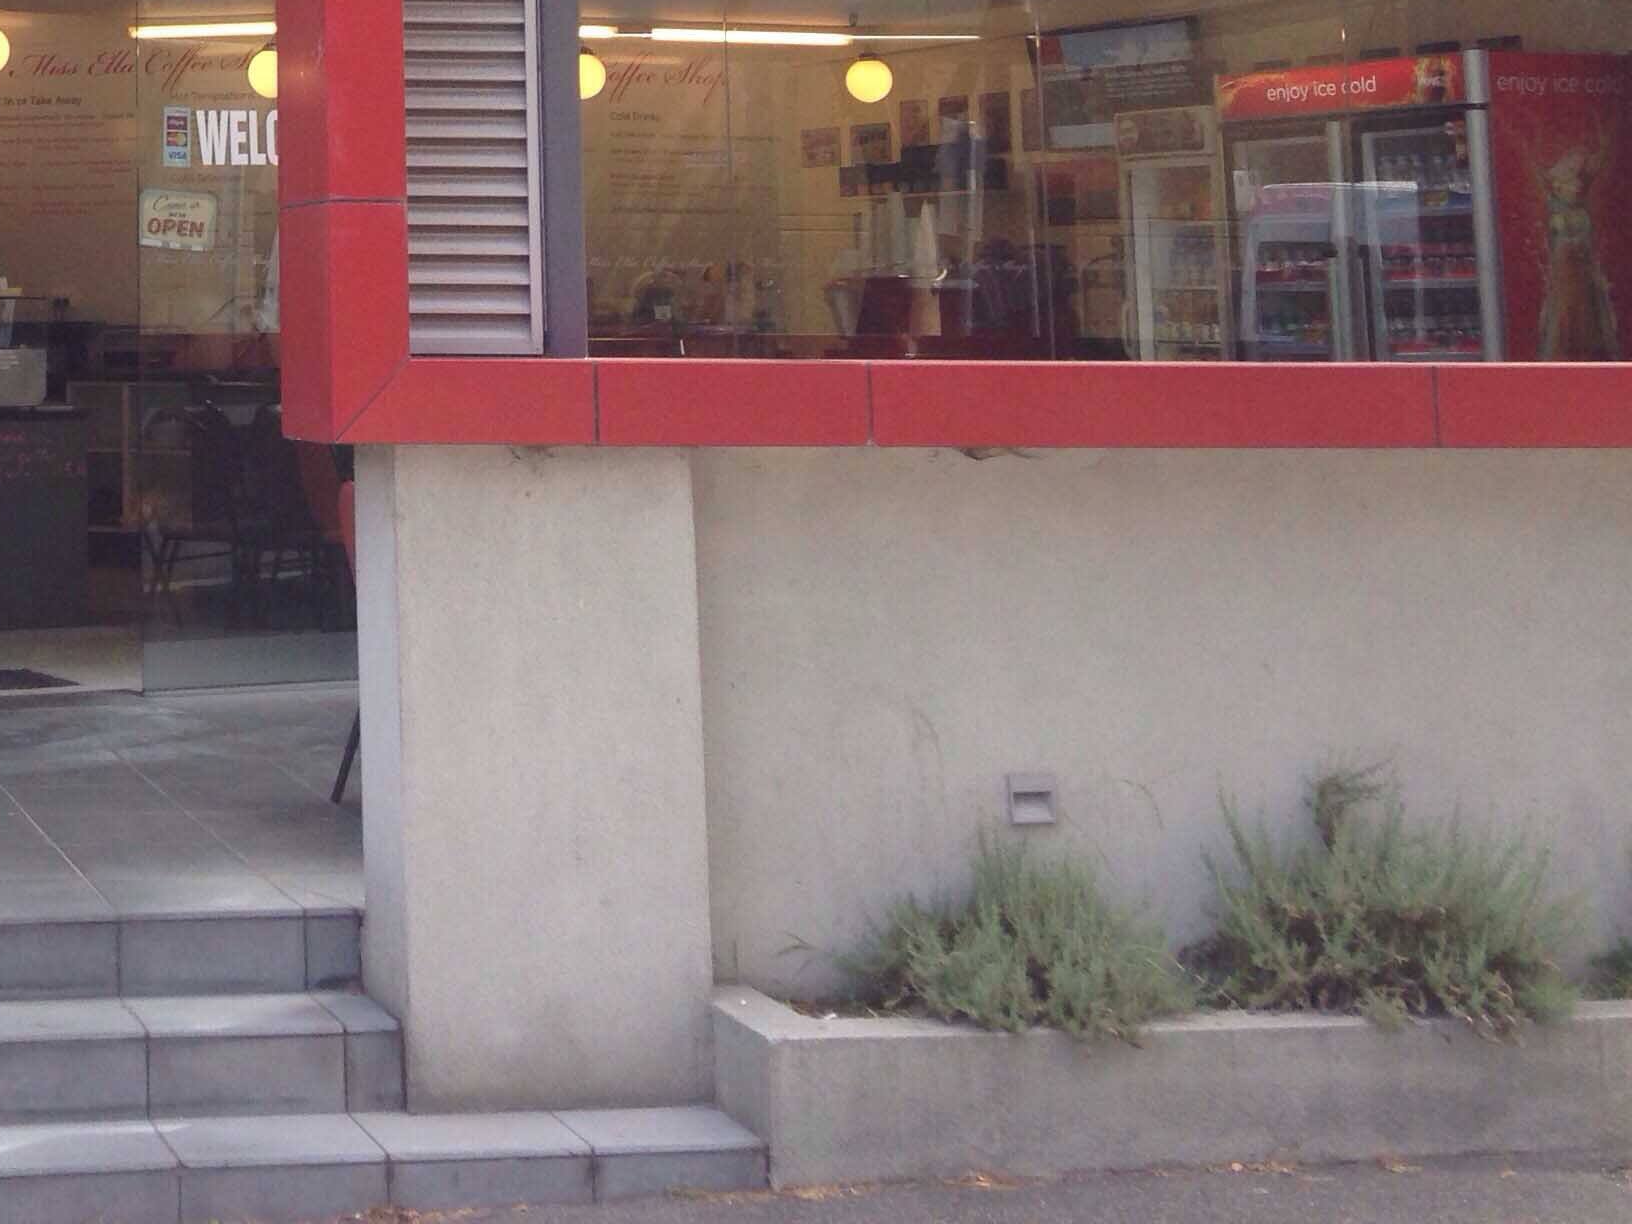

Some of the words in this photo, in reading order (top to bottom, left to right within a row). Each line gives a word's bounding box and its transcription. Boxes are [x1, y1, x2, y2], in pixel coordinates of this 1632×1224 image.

[606, 49, 657, 104] offee
[1496, 76, 1548, 97] enjoy
[1551, 75, 1578, 94] ice
[1266, 84, 1309, 103] enjoy
[1312, 80, 1337, 97] ice
[1340, 76, 1377, 95] cold
[196, 109, 280, 166] WELC
[168, 151, 187, 160] VISA
[146, 217, 206, 238] OPEN
